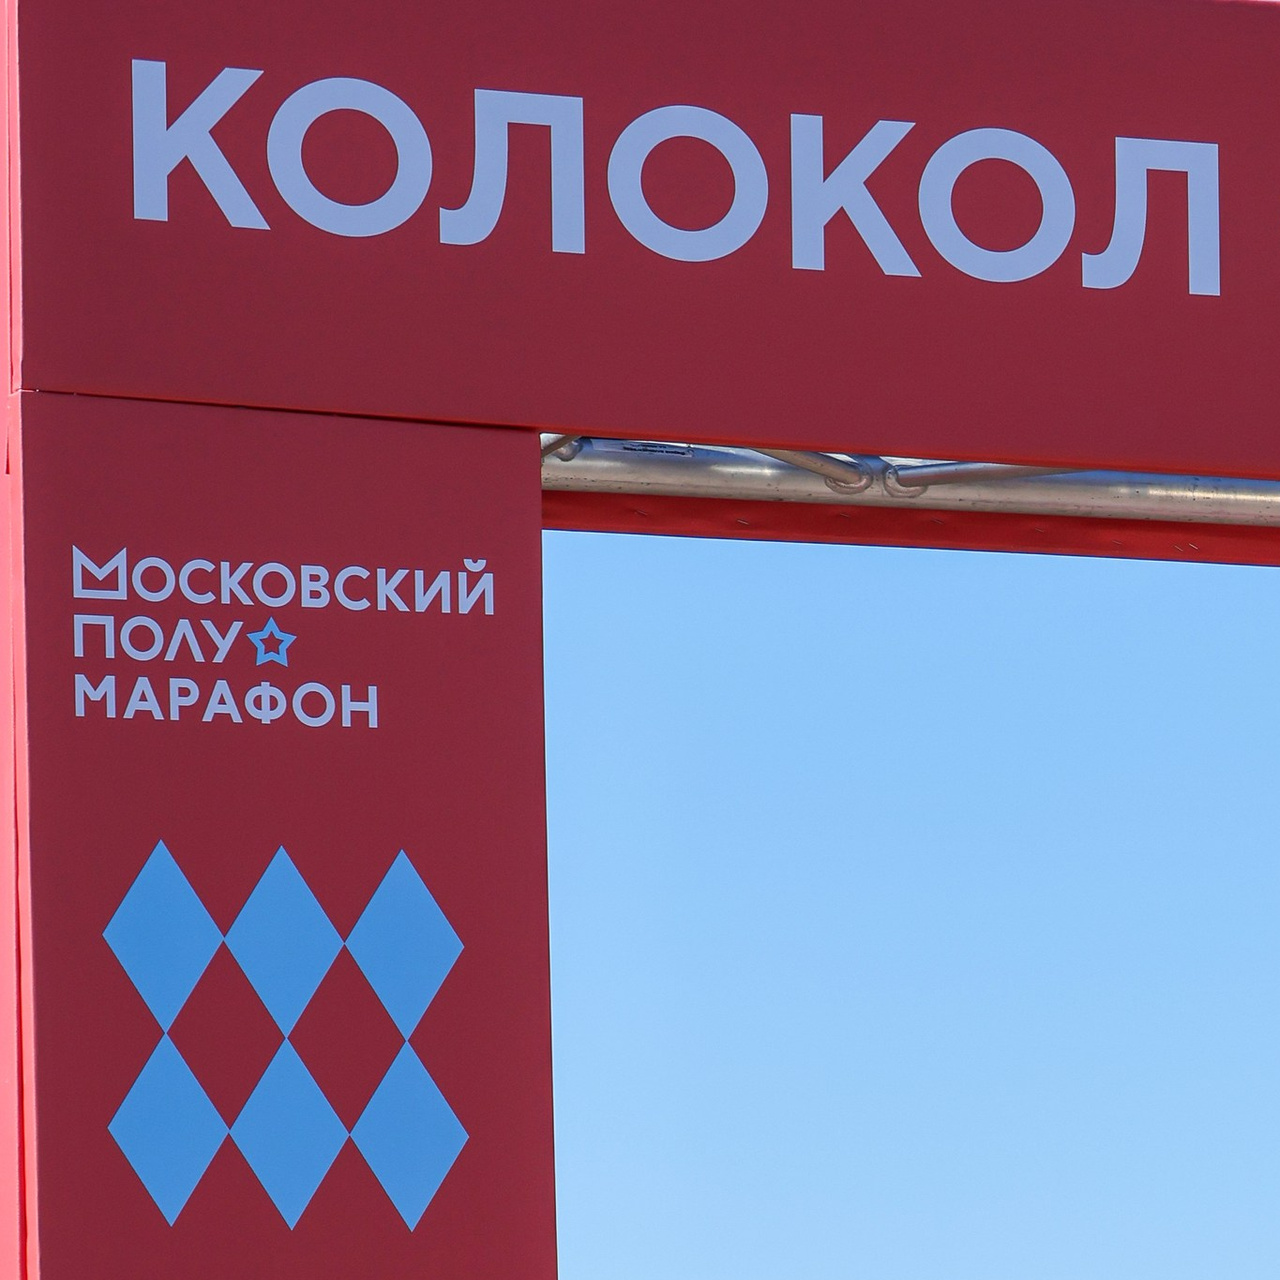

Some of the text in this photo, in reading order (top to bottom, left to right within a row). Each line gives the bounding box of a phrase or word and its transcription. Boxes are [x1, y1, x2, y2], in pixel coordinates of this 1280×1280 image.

[132, 59, 1221, 296] КОЛОКОЛ
[73, 545, 494, 617] МОСКОВСКИЙ
[74, 615, 243, 664] ПОЛУ
[75, 674, 378, 729] МАРАФОН
